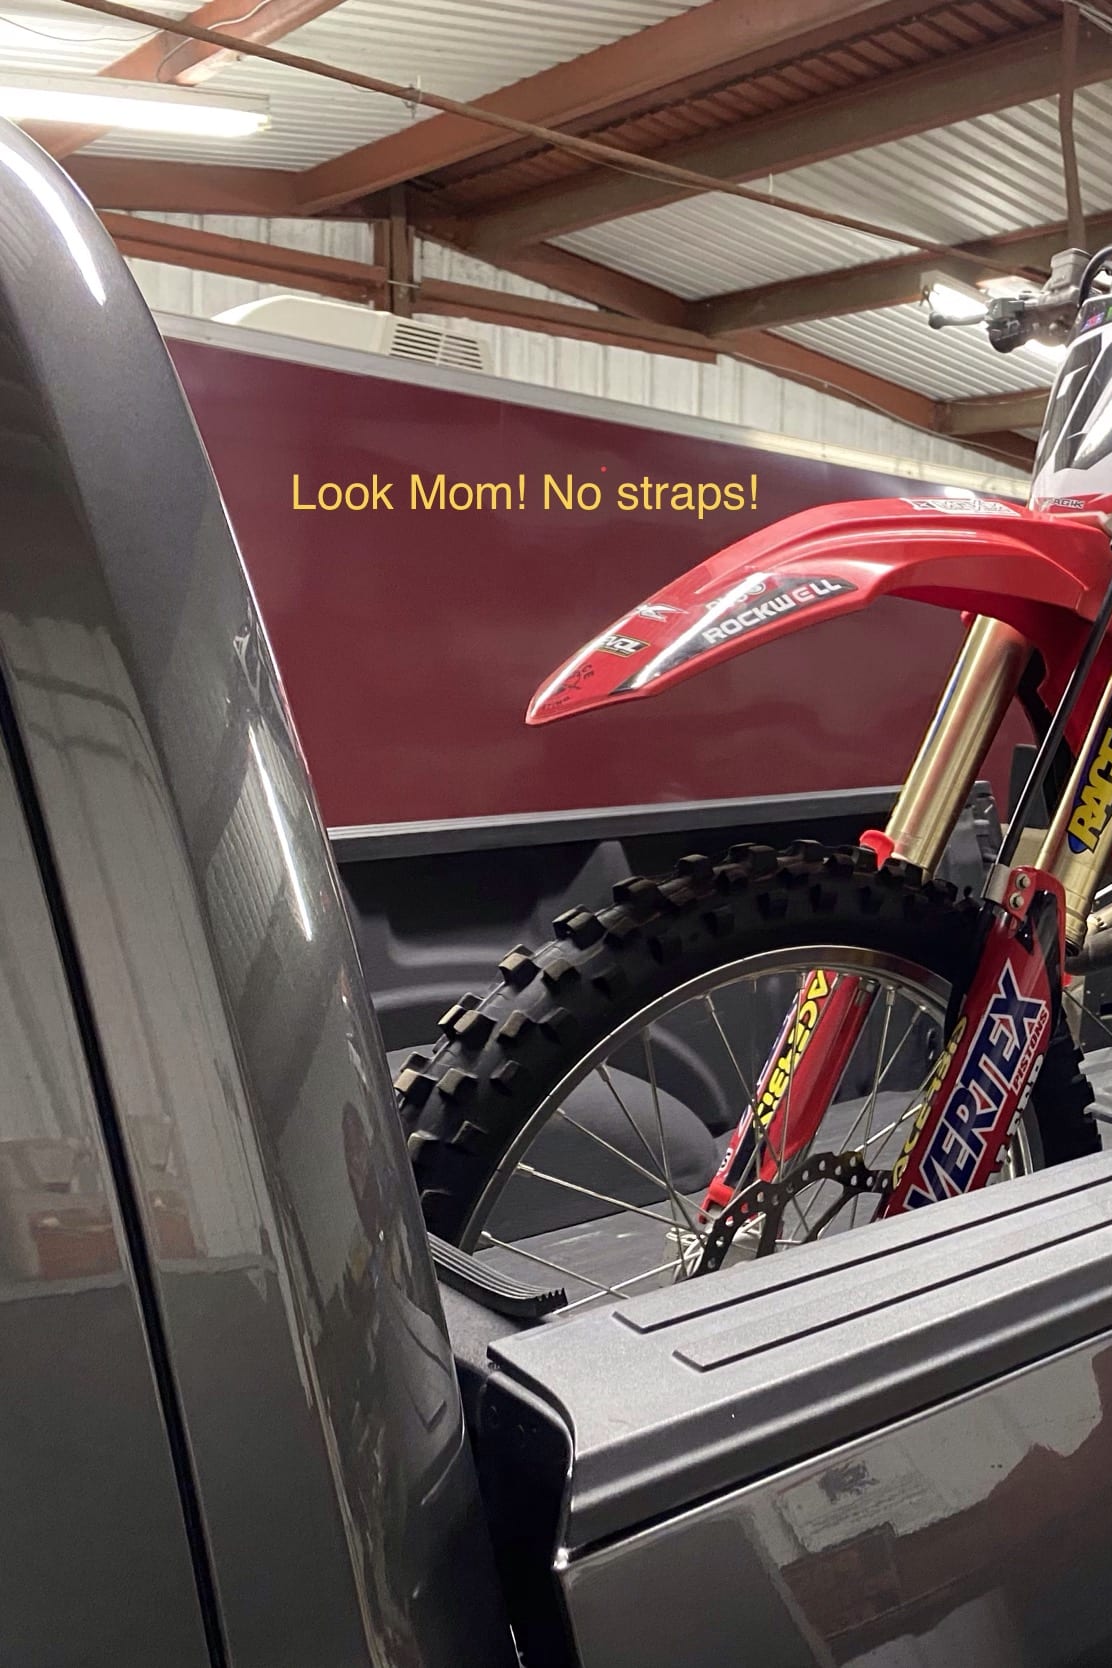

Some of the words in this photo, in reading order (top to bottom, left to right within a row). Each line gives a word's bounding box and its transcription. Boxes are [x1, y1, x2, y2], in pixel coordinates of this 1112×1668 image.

[702, 579, 842, 644] ROCKWELL
[903, 957, 1047, 1209] VERTEX
[1011, 1007, 1049, 1095] PISTONS
